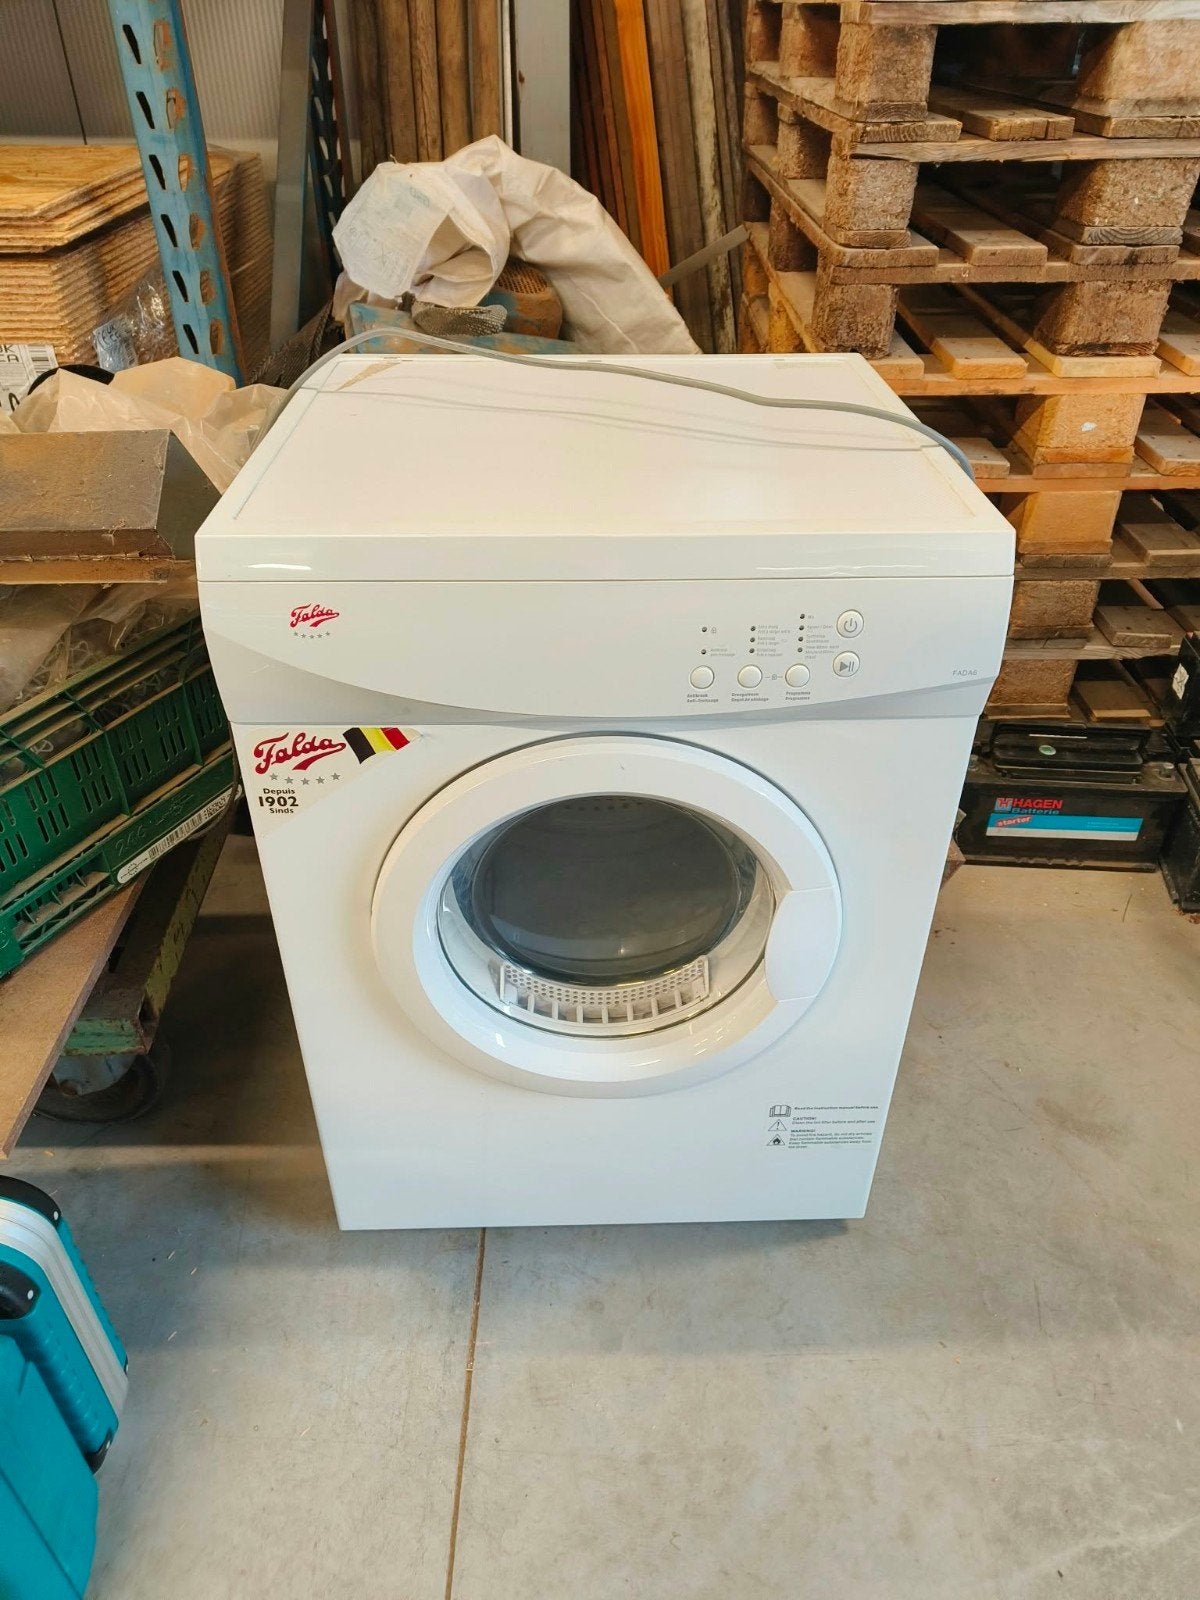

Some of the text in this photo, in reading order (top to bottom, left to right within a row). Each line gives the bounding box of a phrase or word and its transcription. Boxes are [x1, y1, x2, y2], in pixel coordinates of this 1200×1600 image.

[289, 603, 340, 628] Falda
[253, 732, 347, 775] Falda
[263, 788, 296, 796] Depuis
[258, 796, 299, 808] 1902
[1012, 798, 1064, 810] HAGEN
[269, 807, 295, 815] Sinds
[1011, 808, 1060, 816] Batterie
[997, 816, 1032, 827] starter
